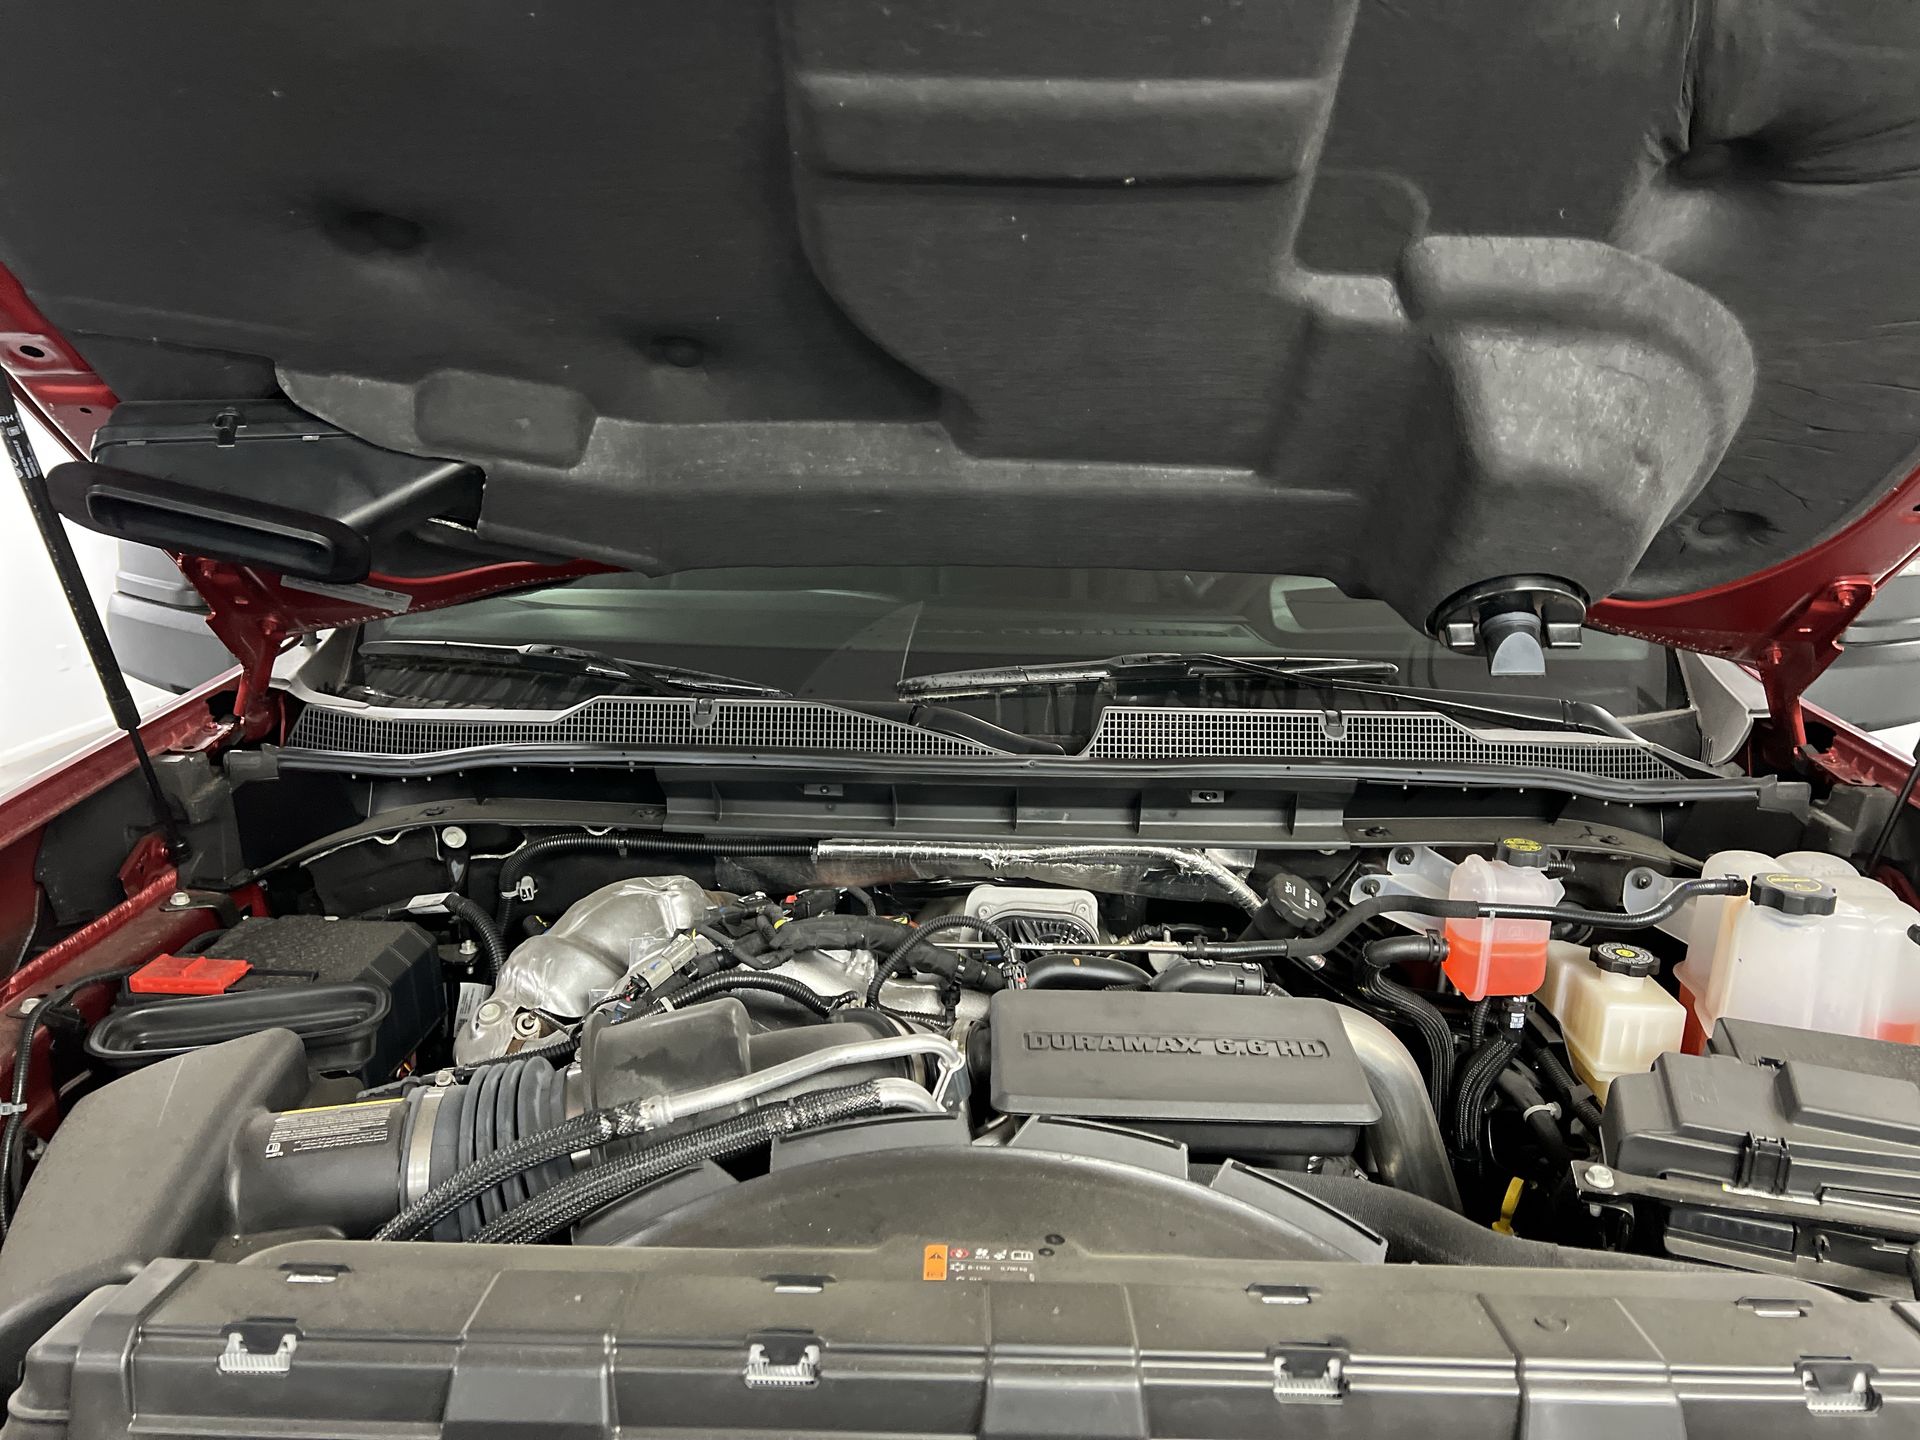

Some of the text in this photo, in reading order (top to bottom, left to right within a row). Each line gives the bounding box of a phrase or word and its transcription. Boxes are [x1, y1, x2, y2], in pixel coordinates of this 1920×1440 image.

[1027, 1033, 1324, 1058] DURAMAX 6.6 HD
